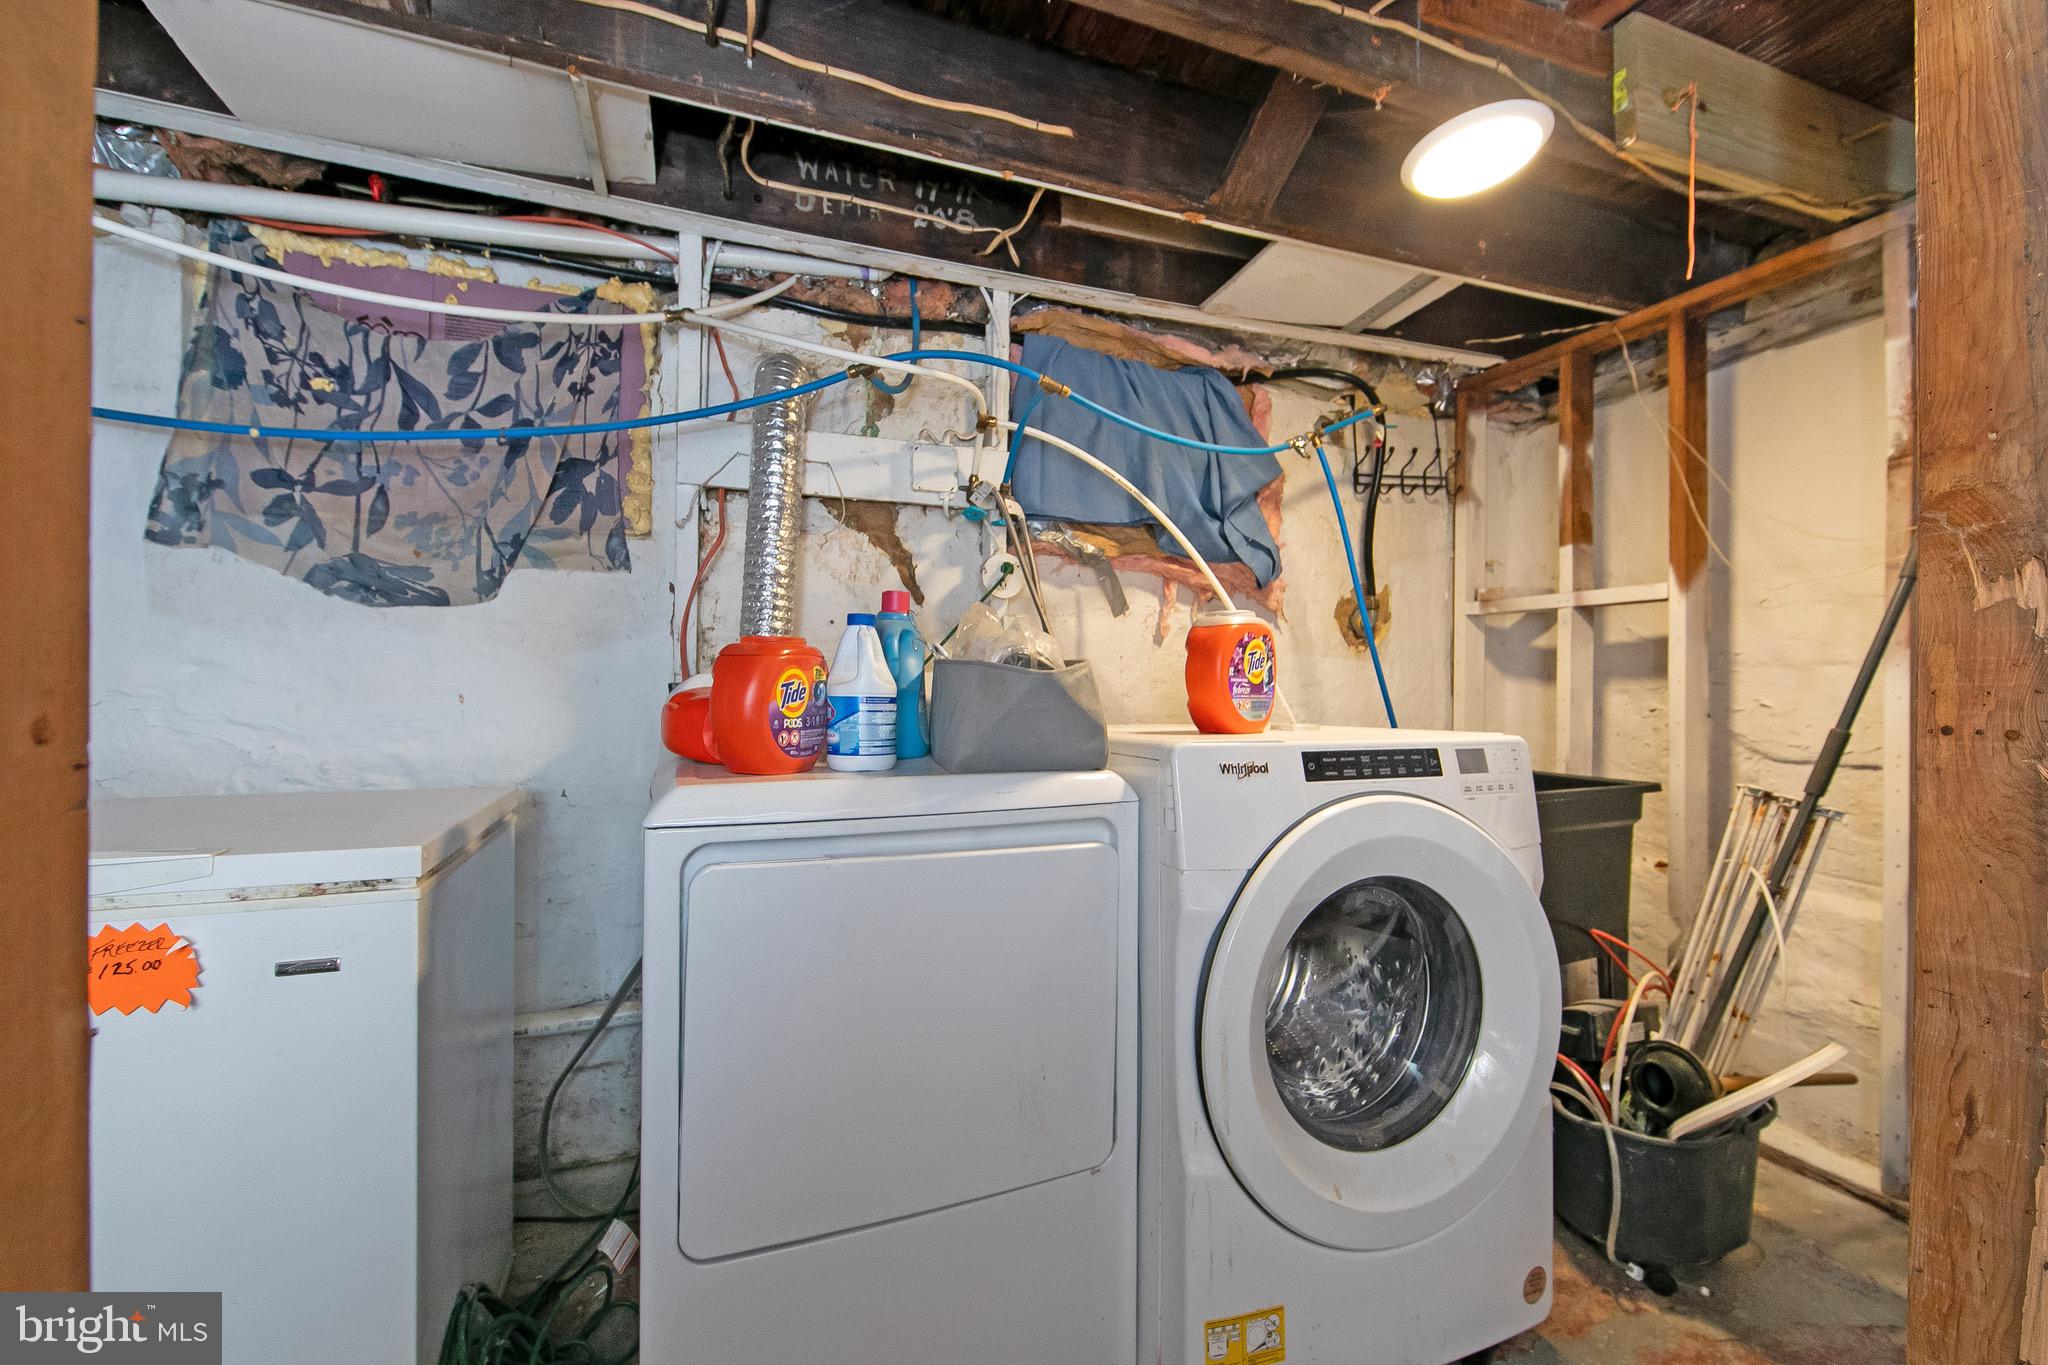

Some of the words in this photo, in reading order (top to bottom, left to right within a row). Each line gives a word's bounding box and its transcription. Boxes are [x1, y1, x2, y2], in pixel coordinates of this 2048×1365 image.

[796, 154, 896, 193] WATER
[1248, 651, 1266, 675] Tide
[780, 681, 807, 710] Tide
[783, 718, 803, 728] PODS
[1219, 762, 1269, 778] Whirlpool
